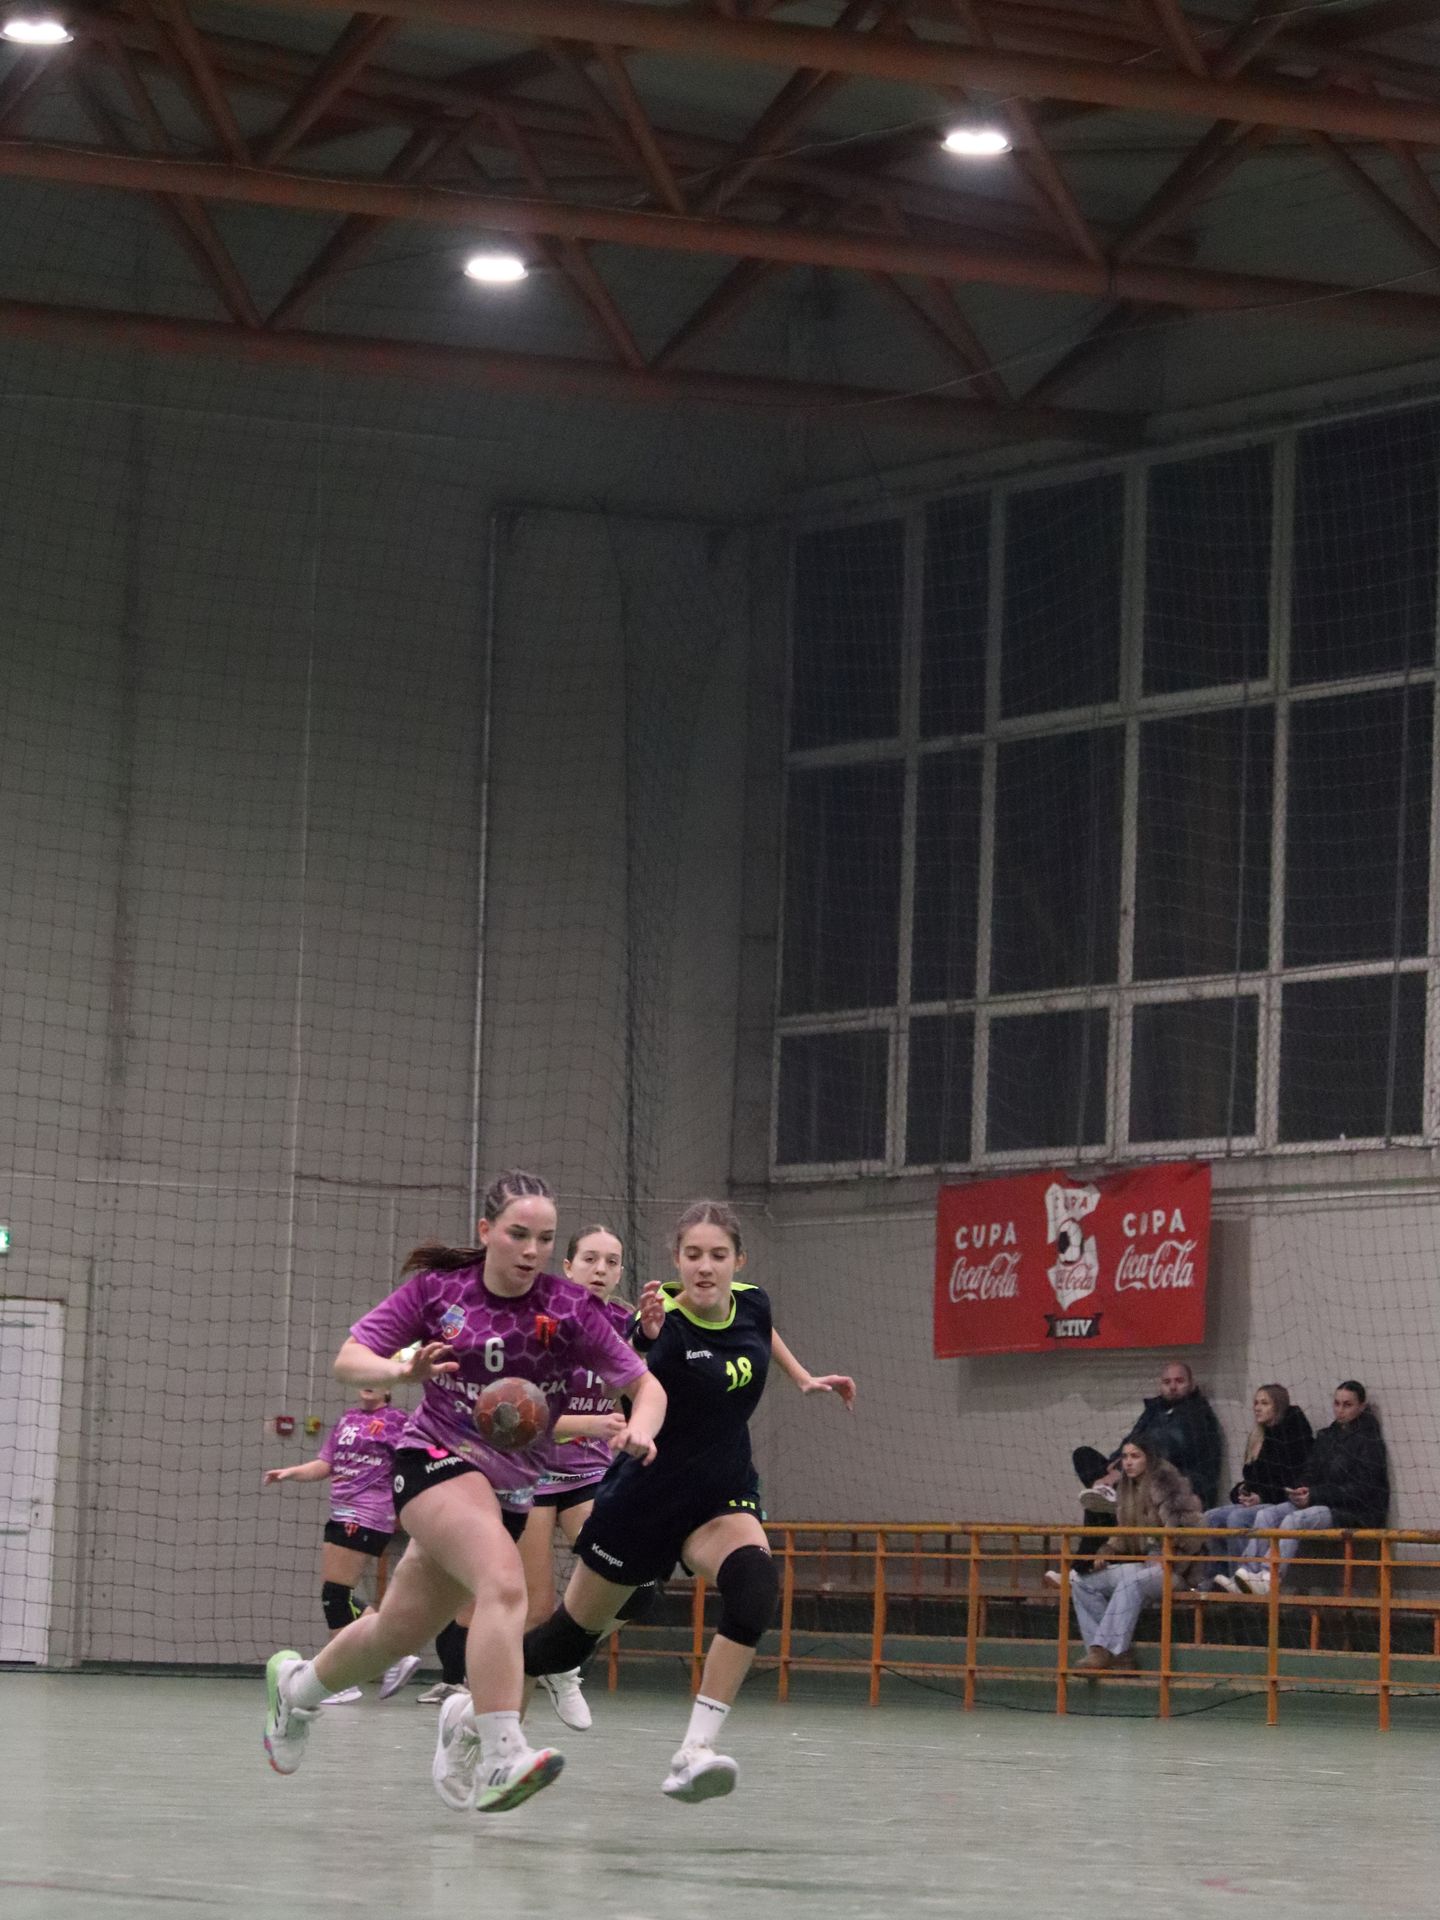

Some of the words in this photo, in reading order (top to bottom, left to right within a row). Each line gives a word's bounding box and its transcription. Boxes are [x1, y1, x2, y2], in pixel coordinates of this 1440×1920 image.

[955, 1222, 1017, 1249] CUPA
[485, 1336, 504, 1372] 6
[686, 1350, 713, 1360] Kemp
[726, 1356, 752, 1392] 18
[338, 1426, 360, 1445] 25
[592, 1543, 624, 1568] Kempa
